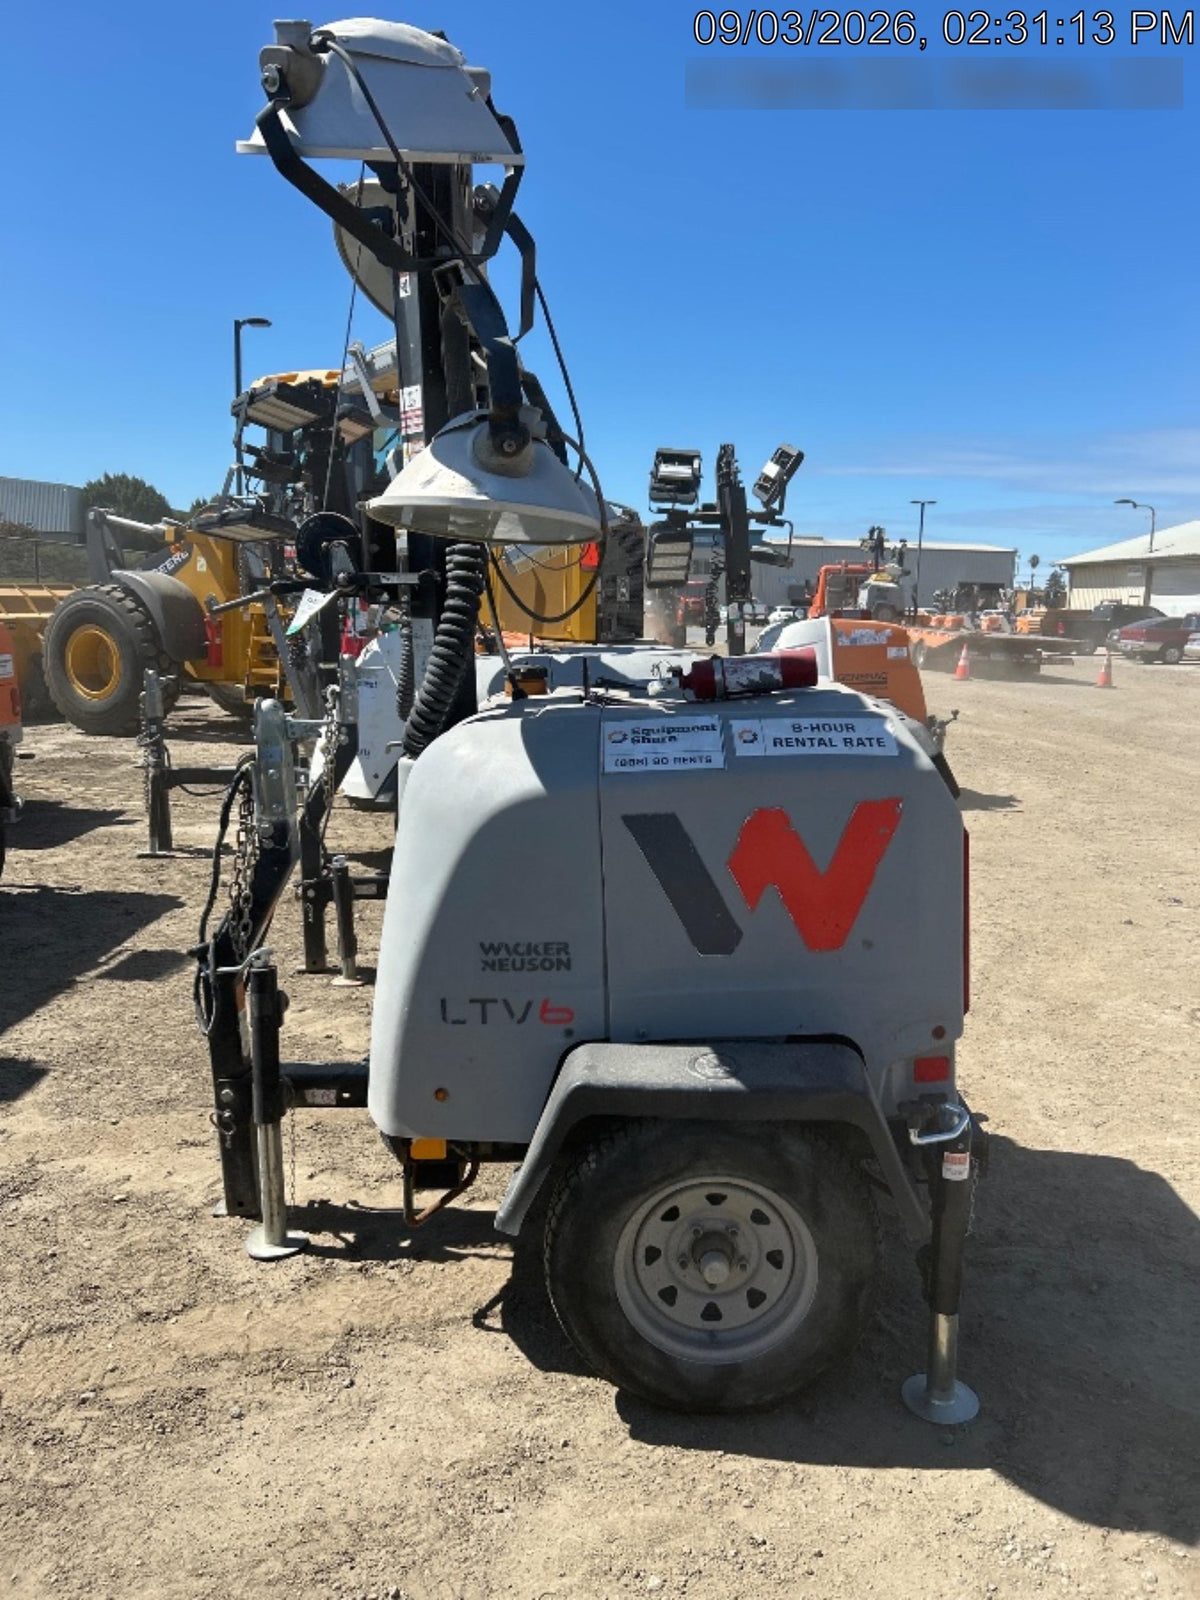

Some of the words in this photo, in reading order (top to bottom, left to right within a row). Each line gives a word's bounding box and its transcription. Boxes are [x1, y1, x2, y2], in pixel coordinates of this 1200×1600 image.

[791, 722, 856, 733] 8-HOUR
[772, 737, 838, 748] RENTAL
[843, 737, 887, 748] RATE
[479, 941, 570, 956] WACKER
[481, 957, 572, 972] NEUSON
[440, 997, 575, 1025] LTV6
